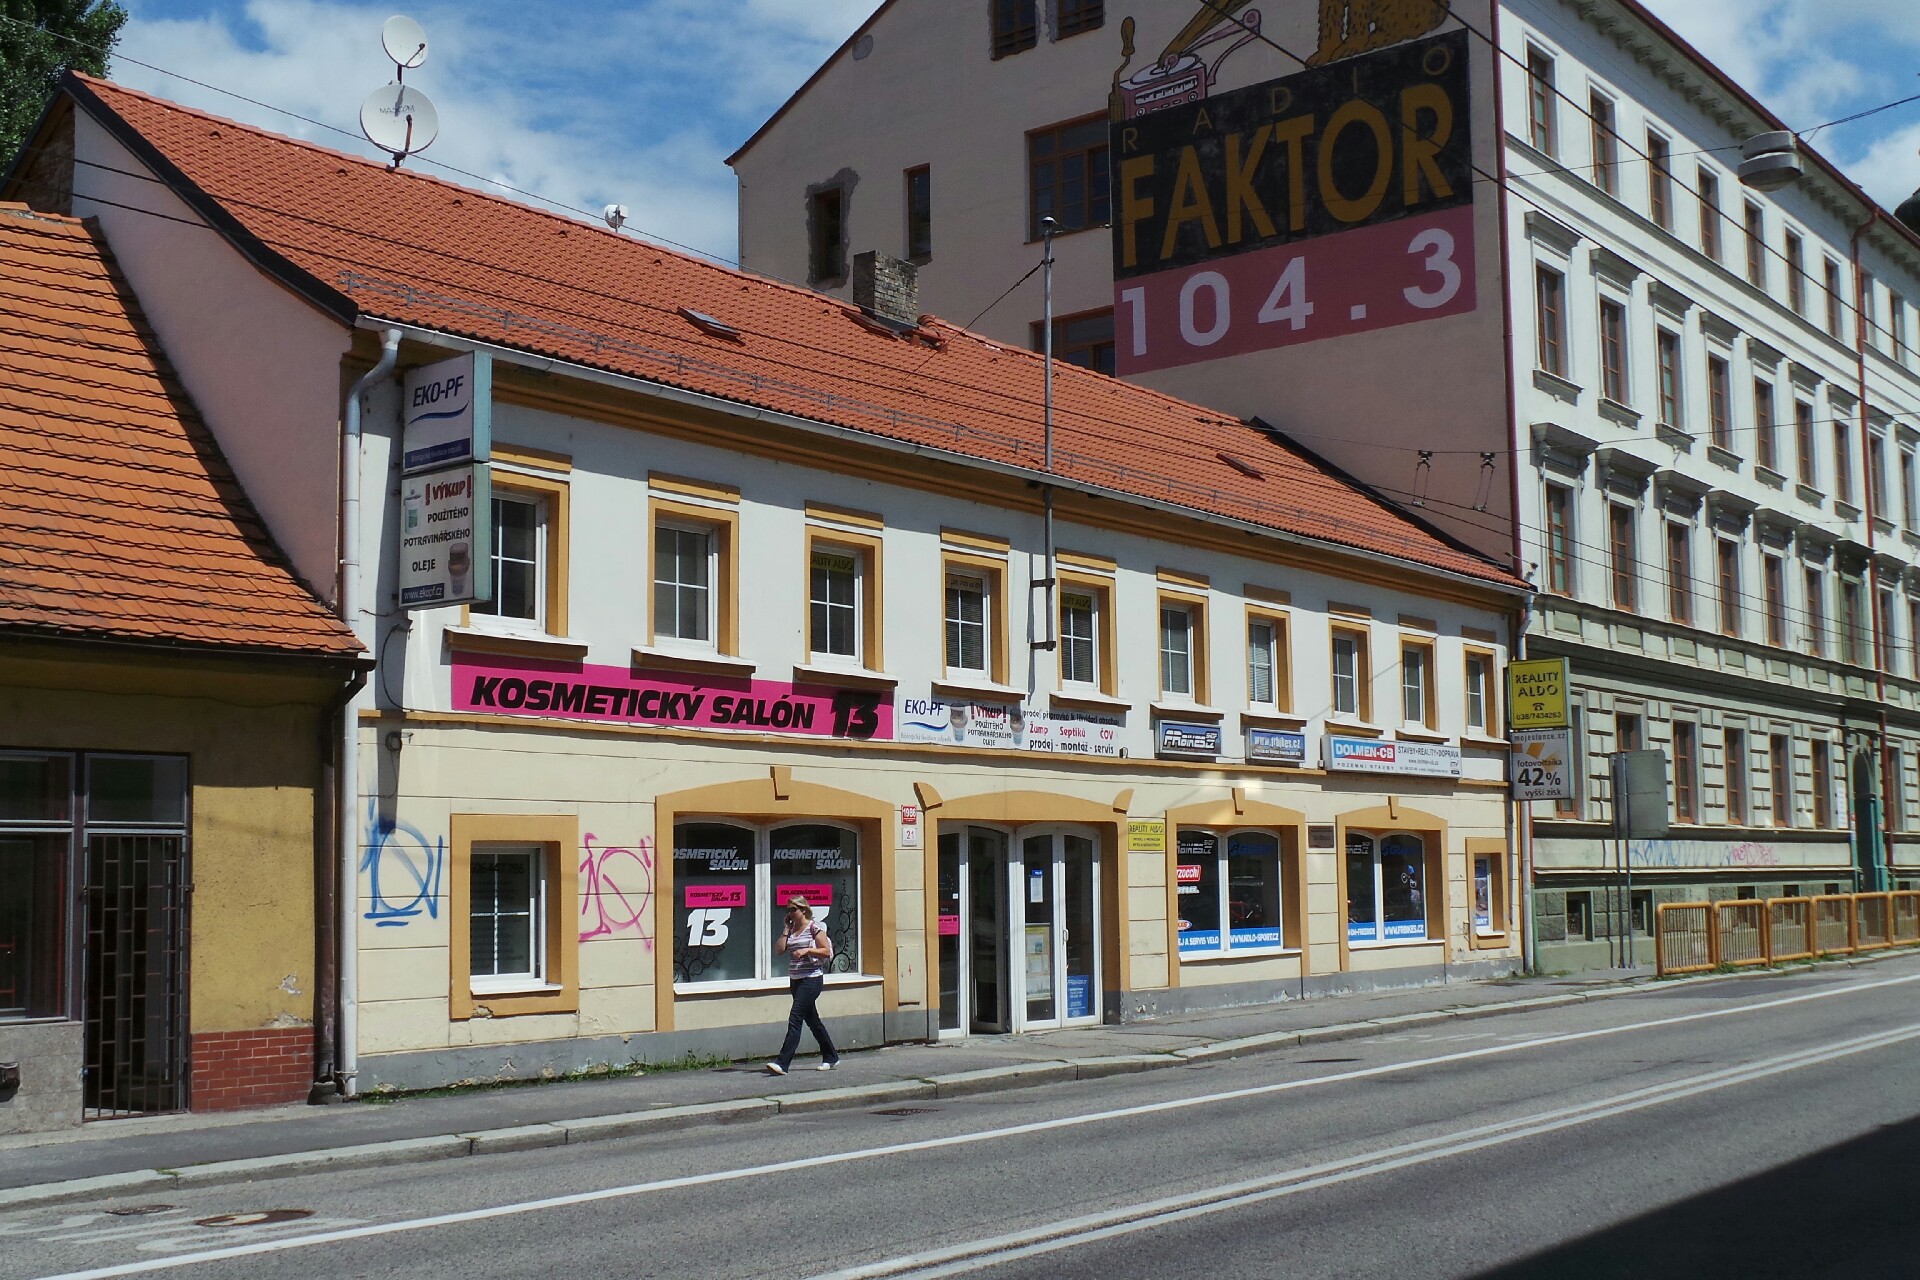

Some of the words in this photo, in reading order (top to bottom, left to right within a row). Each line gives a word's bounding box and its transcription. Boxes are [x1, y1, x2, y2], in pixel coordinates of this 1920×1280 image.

[1122, 47, 1451, 153] RADIO
[1120, 83, 1454, 267] FAKTOR
[1122, 228, 1461, 356] 104.3
[412, 375, 464, 408] EKO-PF
[427, 507, 469, 523] POUŽITÉHO
[404, 527, 470, 548] POTRAVINÁŘSKÉHO
[412, 558, 436, 573] OLEJE
[1515, 671, 1559, 684] REALITY
[1517, 684, 1559, 698] ALDO
[470, 676, 706, 721] KOSMETICKÝ
[709, 695, 814, 729] SALÓN
[831, 690, 882, 740] 13
[904, 699, 945, 716] EKO-PF
[1030, 721, 1049, 736] Žump
[1099, 727, 1114, 740] ČOV
[1514, 733, 1565, 742] mojeslunce.cz
[1030, 739, 1053, 752] prodej
[1061, 741, 1088, 752] montáž
[1094, 743, 1114, 754] servis
[1517, 759, 1563, 768] fotovoltaika
[1517, 767, 1561, 787] 42%
[1524, 788, 1545, 799] vyšší
[1546, 787, 1562, 796] zisk
[773, 847, 841, 860] KOSMETICKÝ
[709, 856, 749, 870] SALÓN
[816, 856, 852, 870] SALÓN
[686, 908, 731, 947] 13
